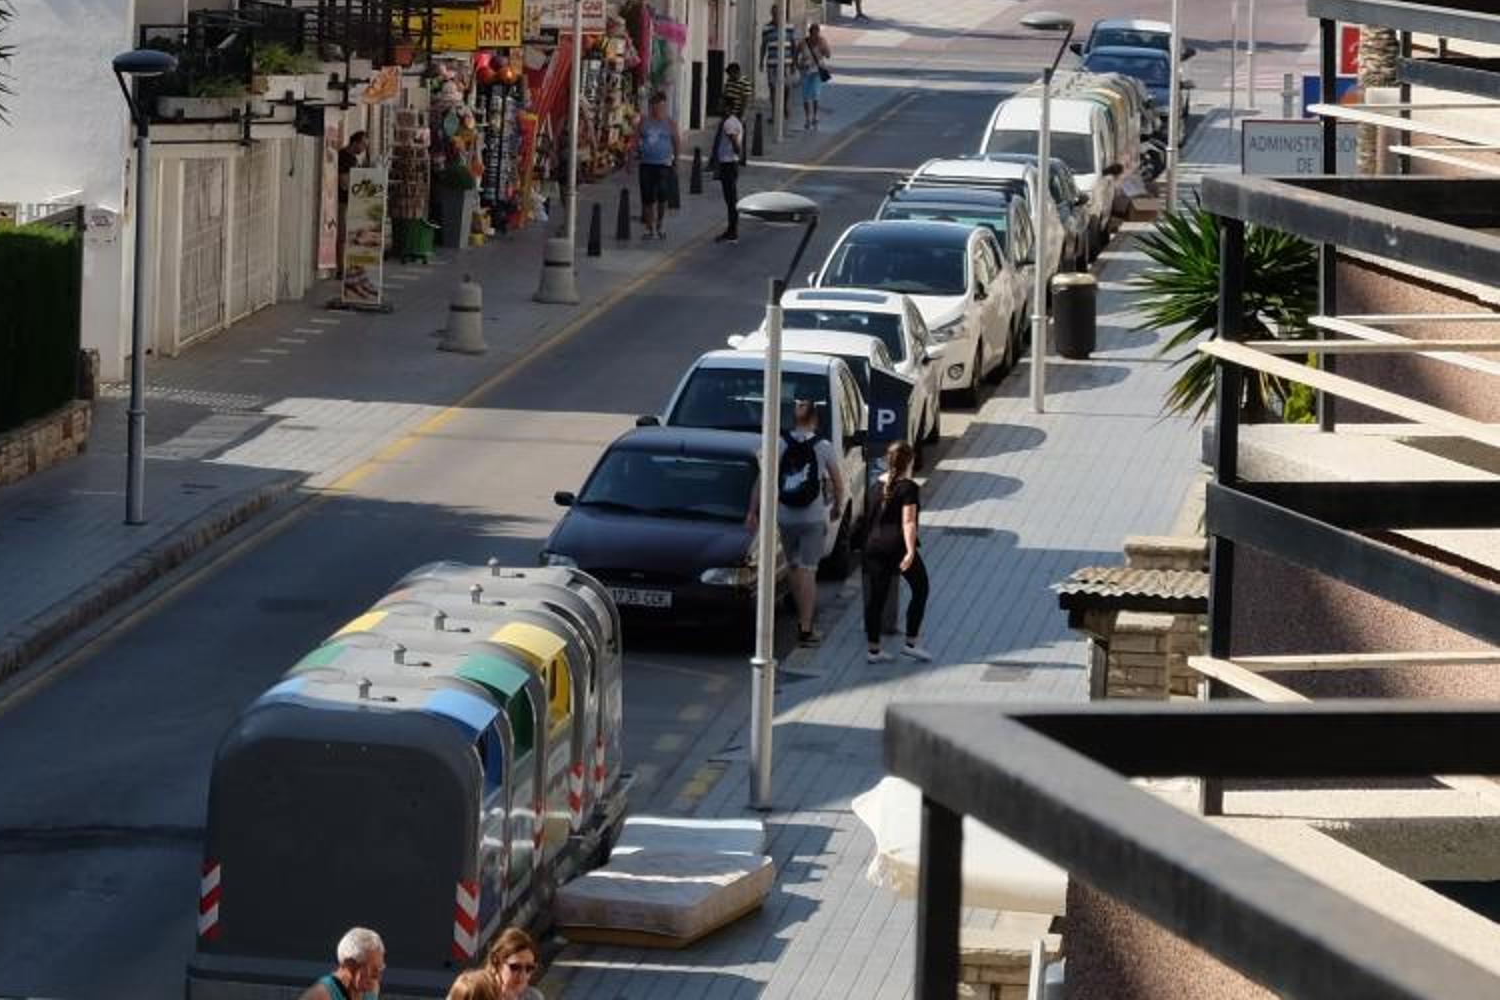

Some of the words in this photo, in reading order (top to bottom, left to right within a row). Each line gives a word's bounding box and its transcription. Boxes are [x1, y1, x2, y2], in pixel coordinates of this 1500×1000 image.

[478, 21, 519, 41] ARKET
[1296, 157, 1316, 173] DE
[876, 408, 897, 432] P
